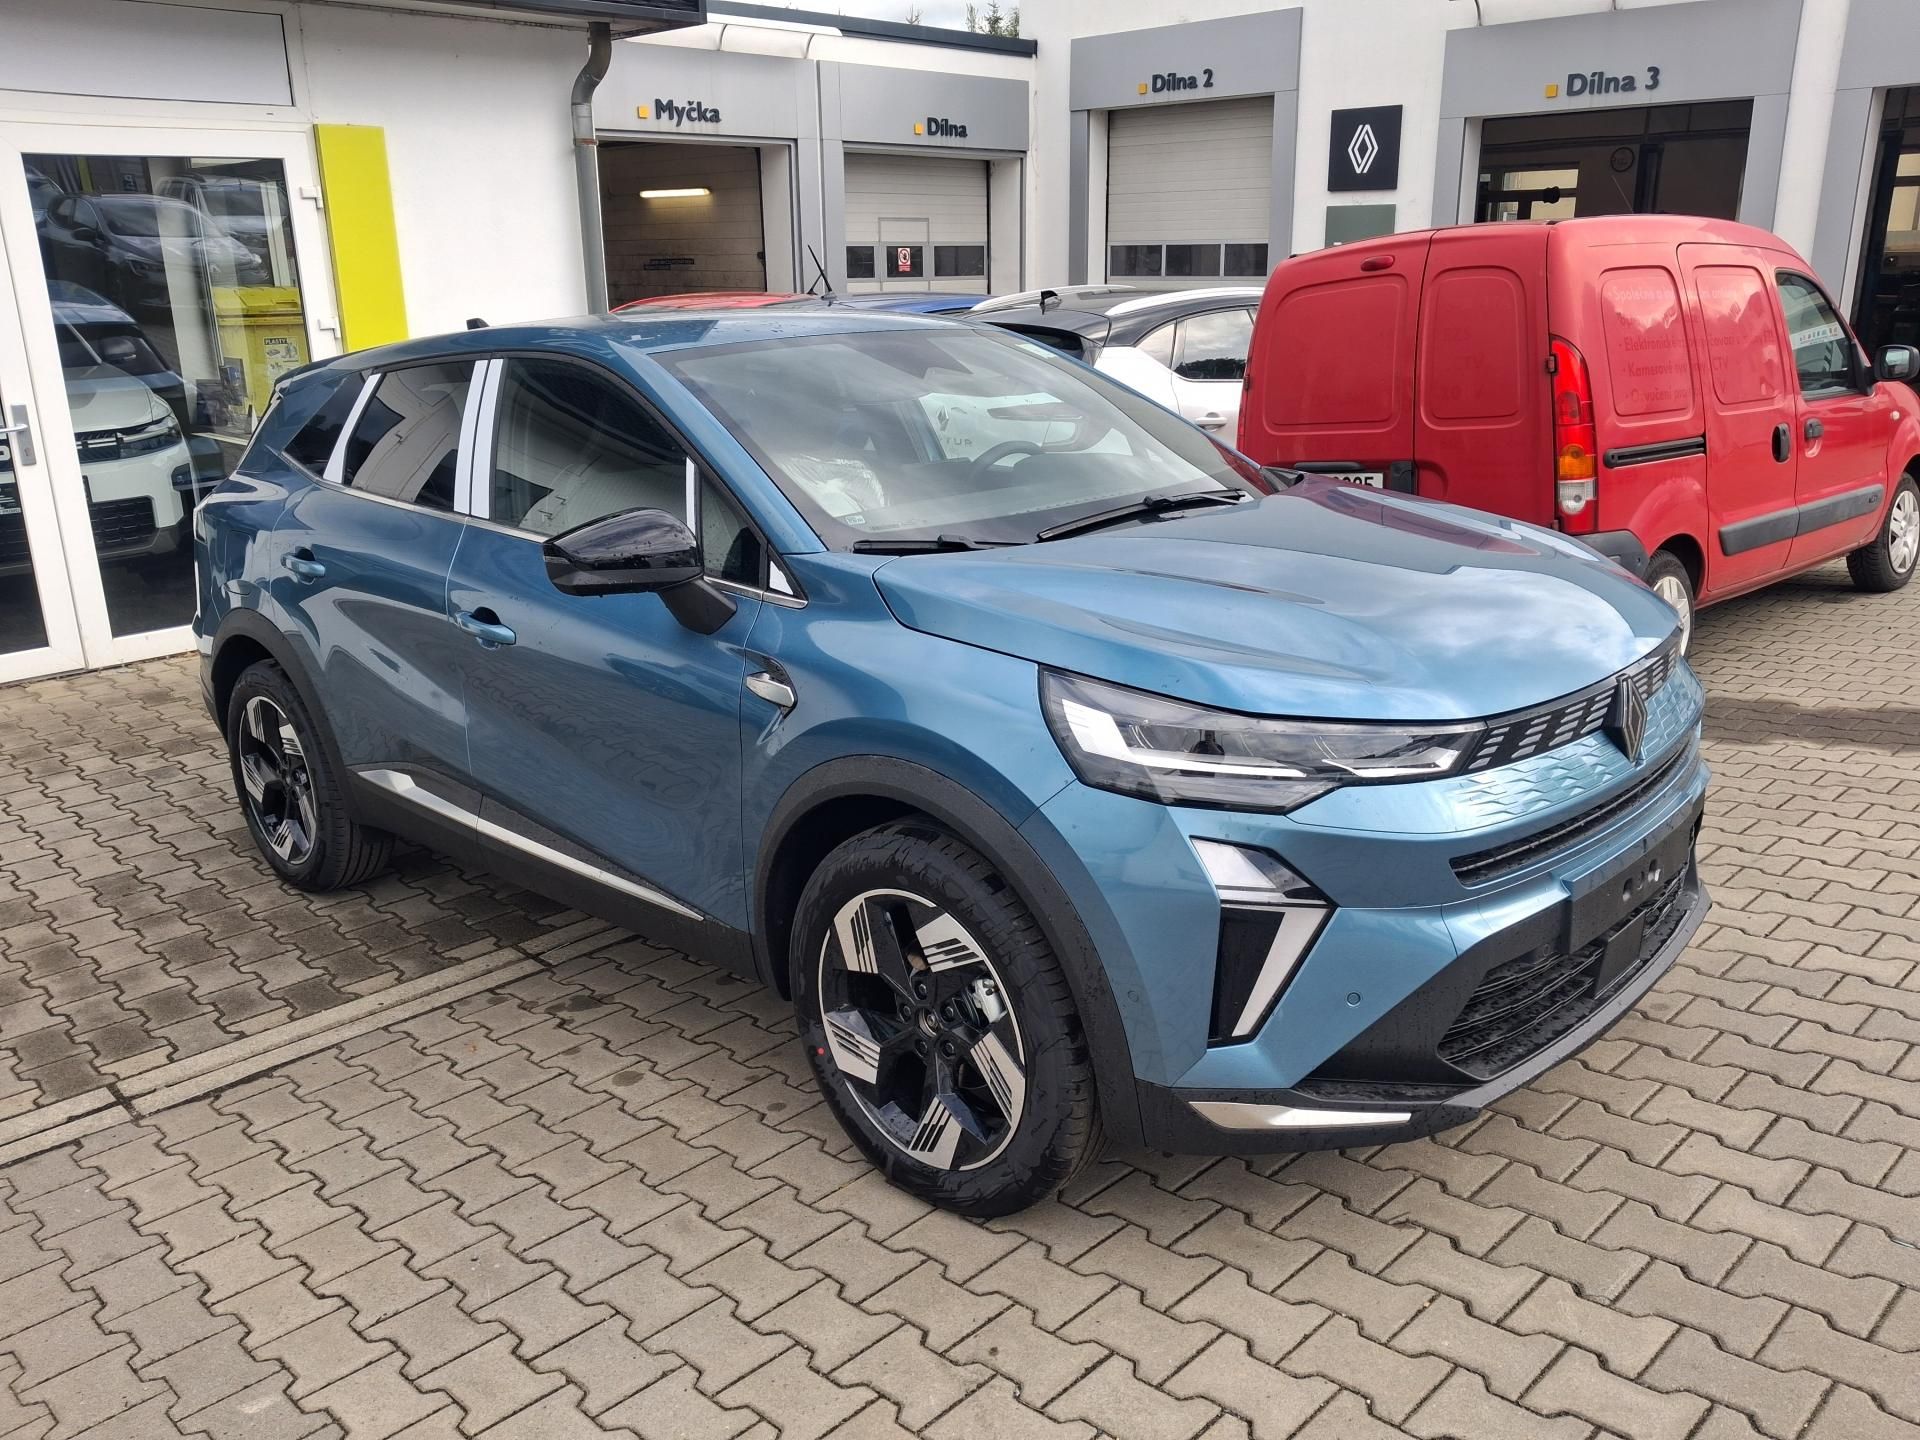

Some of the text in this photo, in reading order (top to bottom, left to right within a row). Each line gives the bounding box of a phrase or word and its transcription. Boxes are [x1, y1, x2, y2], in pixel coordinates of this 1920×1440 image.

[1152, 68, 1214, 93] Dílna 2
[1567, 66, 1660, 97] Dílna 3
[655, 98, 722, 127] Myčka
[927, 116, 968, 138] Dílna
